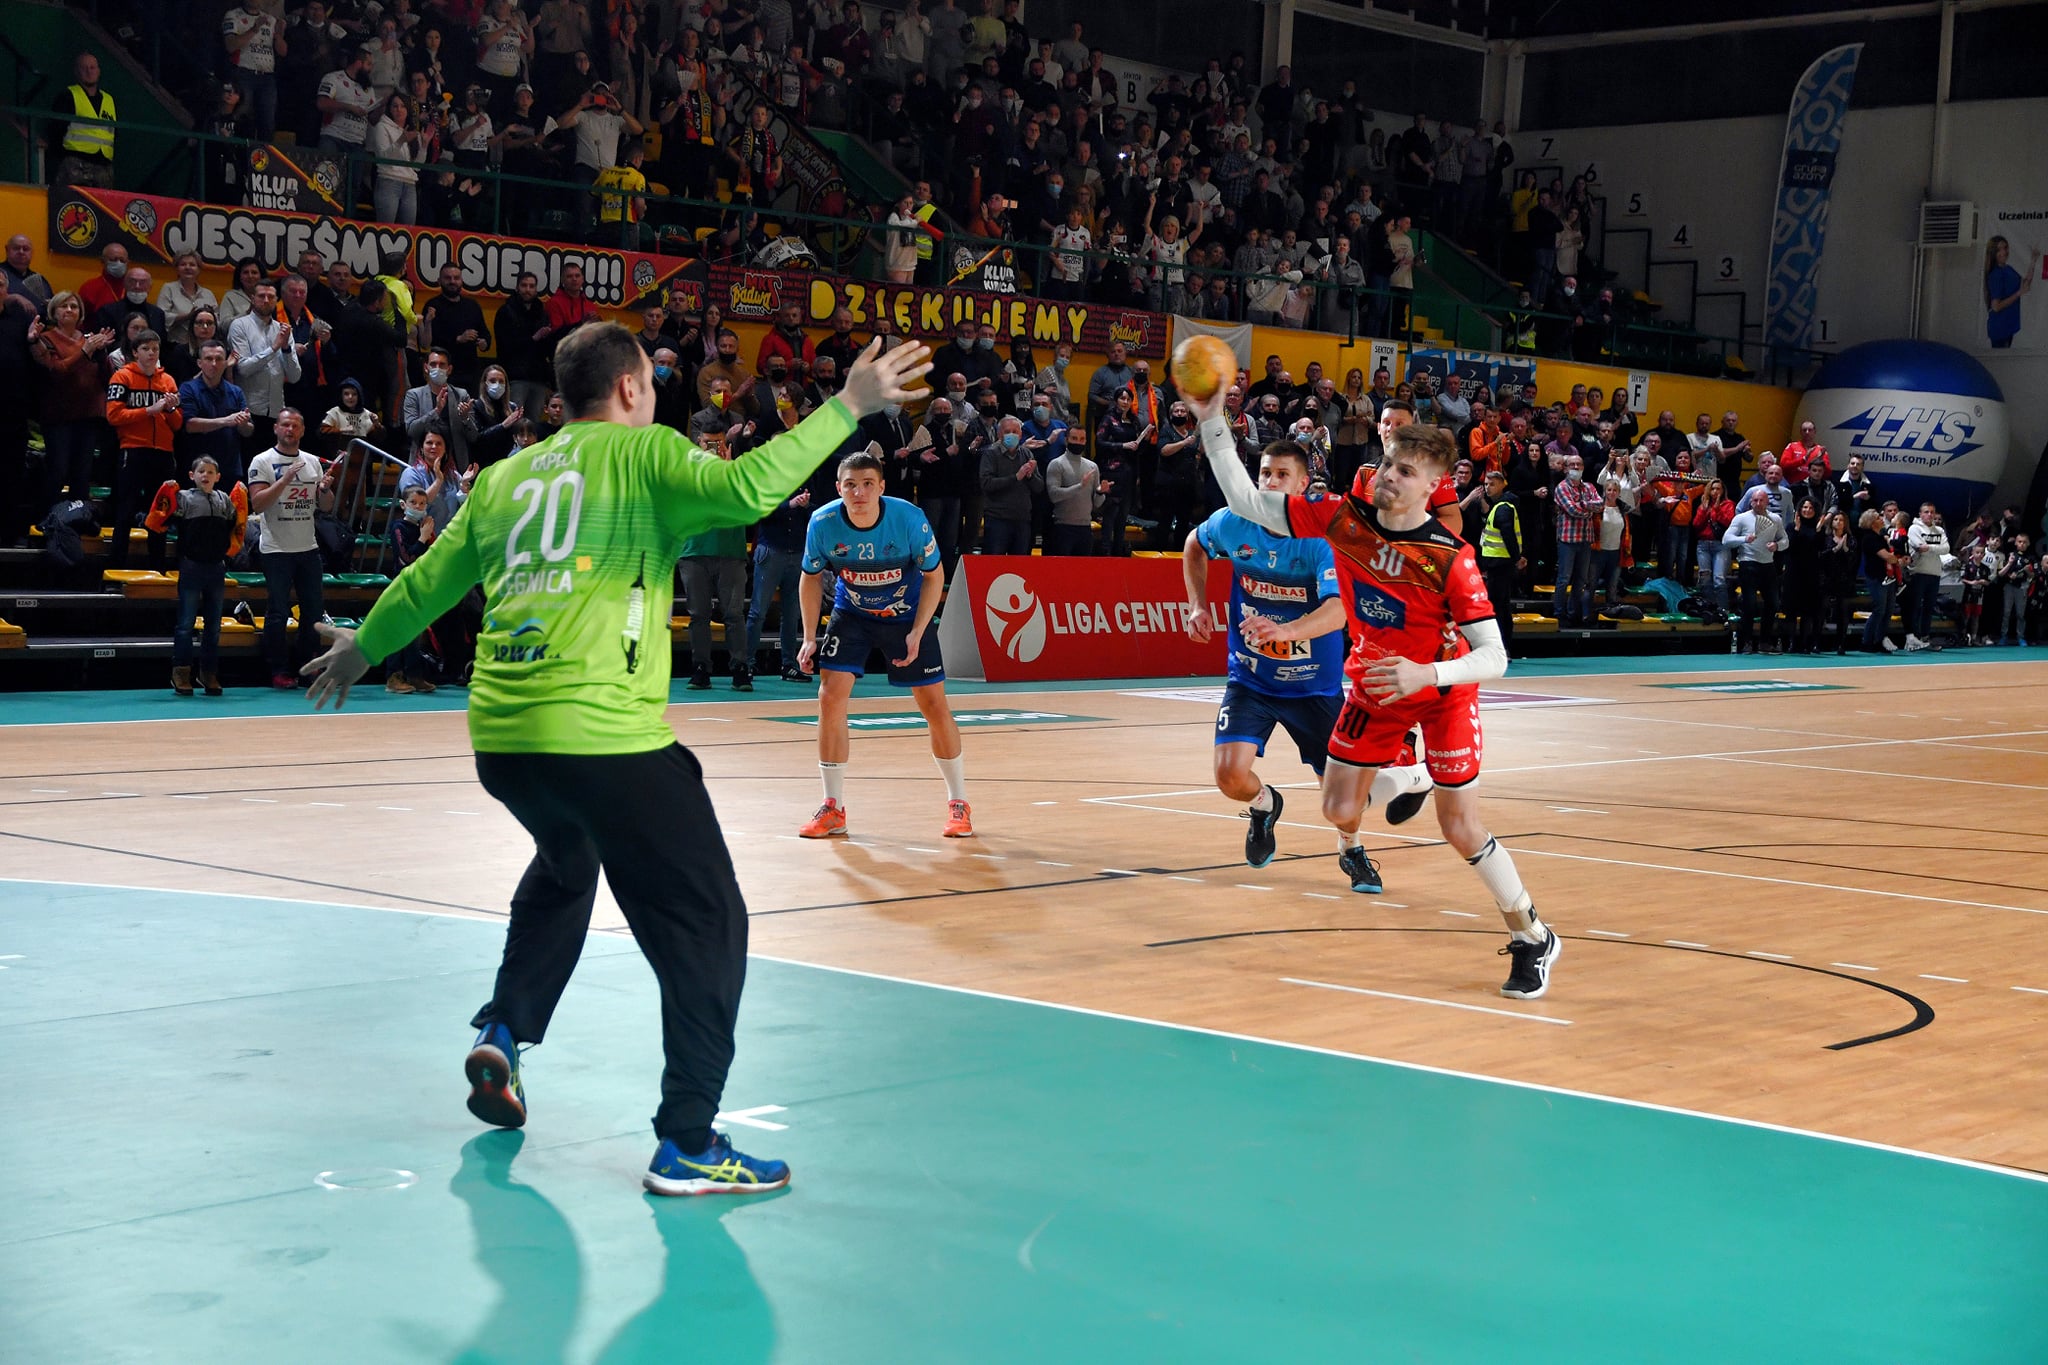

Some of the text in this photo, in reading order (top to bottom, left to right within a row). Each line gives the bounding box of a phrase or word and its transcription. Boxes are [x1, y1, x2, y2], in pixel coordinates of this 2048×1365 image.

[1127, 82, 1137, 103] B
[1541, 138, 1554, 158] 7
[1584, 163, 1597, 183] 6
[251, 173, 298, 197] KLUB
[251, 193, 297, 212] KIBICA
[1628, 194, 1641, 213] 5
[1999, 211, 2043, 221] Uczelnia
[1674, 225, 1687, 245] 4
[419, 237, 450, 287] U
[1720, 257, 1734, 278] 3
[983, 264, 1015, 282] KLUB
[745, 275, 781, 308] MKS
[810, 279, 1088, 345] DZIĘKUJEMY
[1820, 319, 1828, 341] 1
[1374, 345, 1395, 355] SEKTOR
[1631, 375, 1647, 383] SEKTOR
[1634, 384, 1642, 407] F
[1860, 405, 1972, 452] LHS
[1849, 451, 1942, 467] ww.lhs.com.pl
[288, 487, 309, 500] 24
[505, 470, 585, 568] 20
[857, 542, 876, 560] 23
[1267, 550, 1278, 569] 5
[859, 569, 901, 582] HURAS
[1259, 583, 1306, 598] HURAS
[1049, 601, 1230, 634] LIGA CENTRL
[820, 633, 840, 658] 23
[1218, 705, 1231, 731] 5
[1336, 702, 1371, 740] 30
